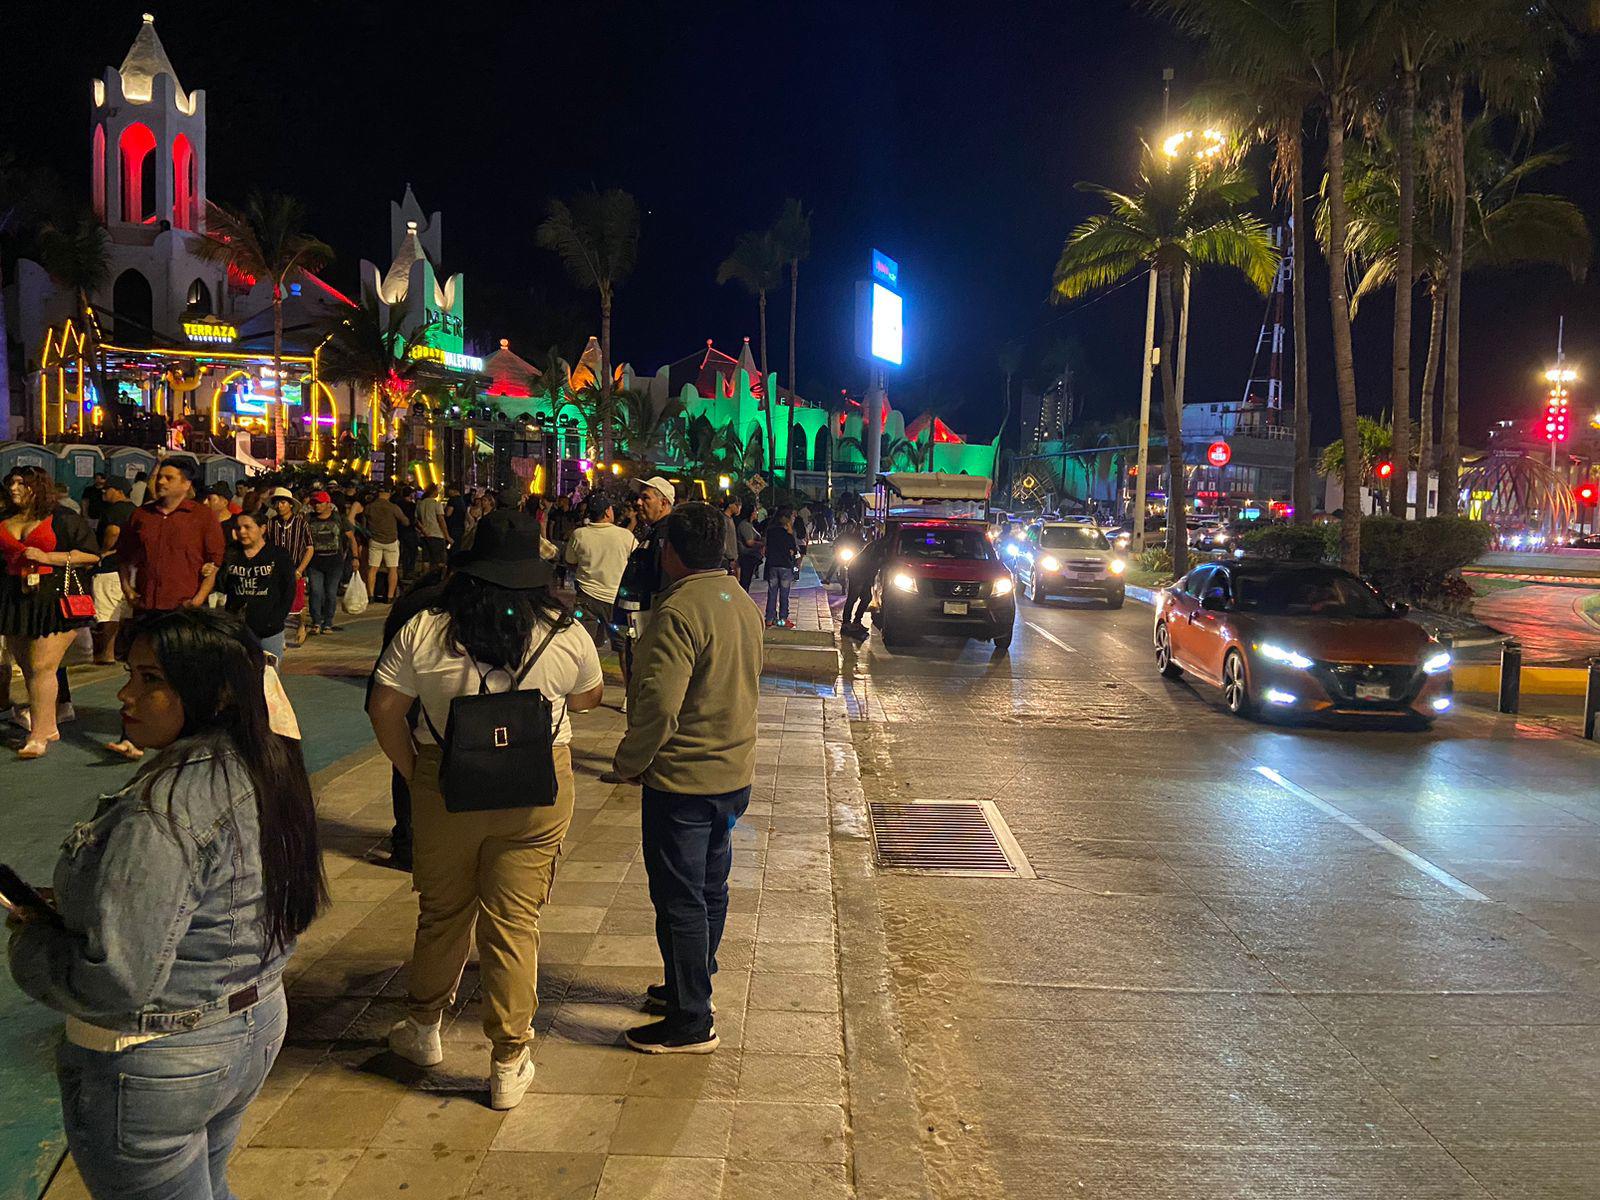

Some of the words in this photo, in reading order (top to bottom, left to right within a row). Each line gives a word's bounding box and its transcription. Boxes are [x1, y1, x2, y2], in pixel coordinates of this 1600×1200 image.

[183, 323, 237, 338] TERRAZA
[445, 351, 482, 371] VALENTINO
[240, 577, 258, 589] THE
